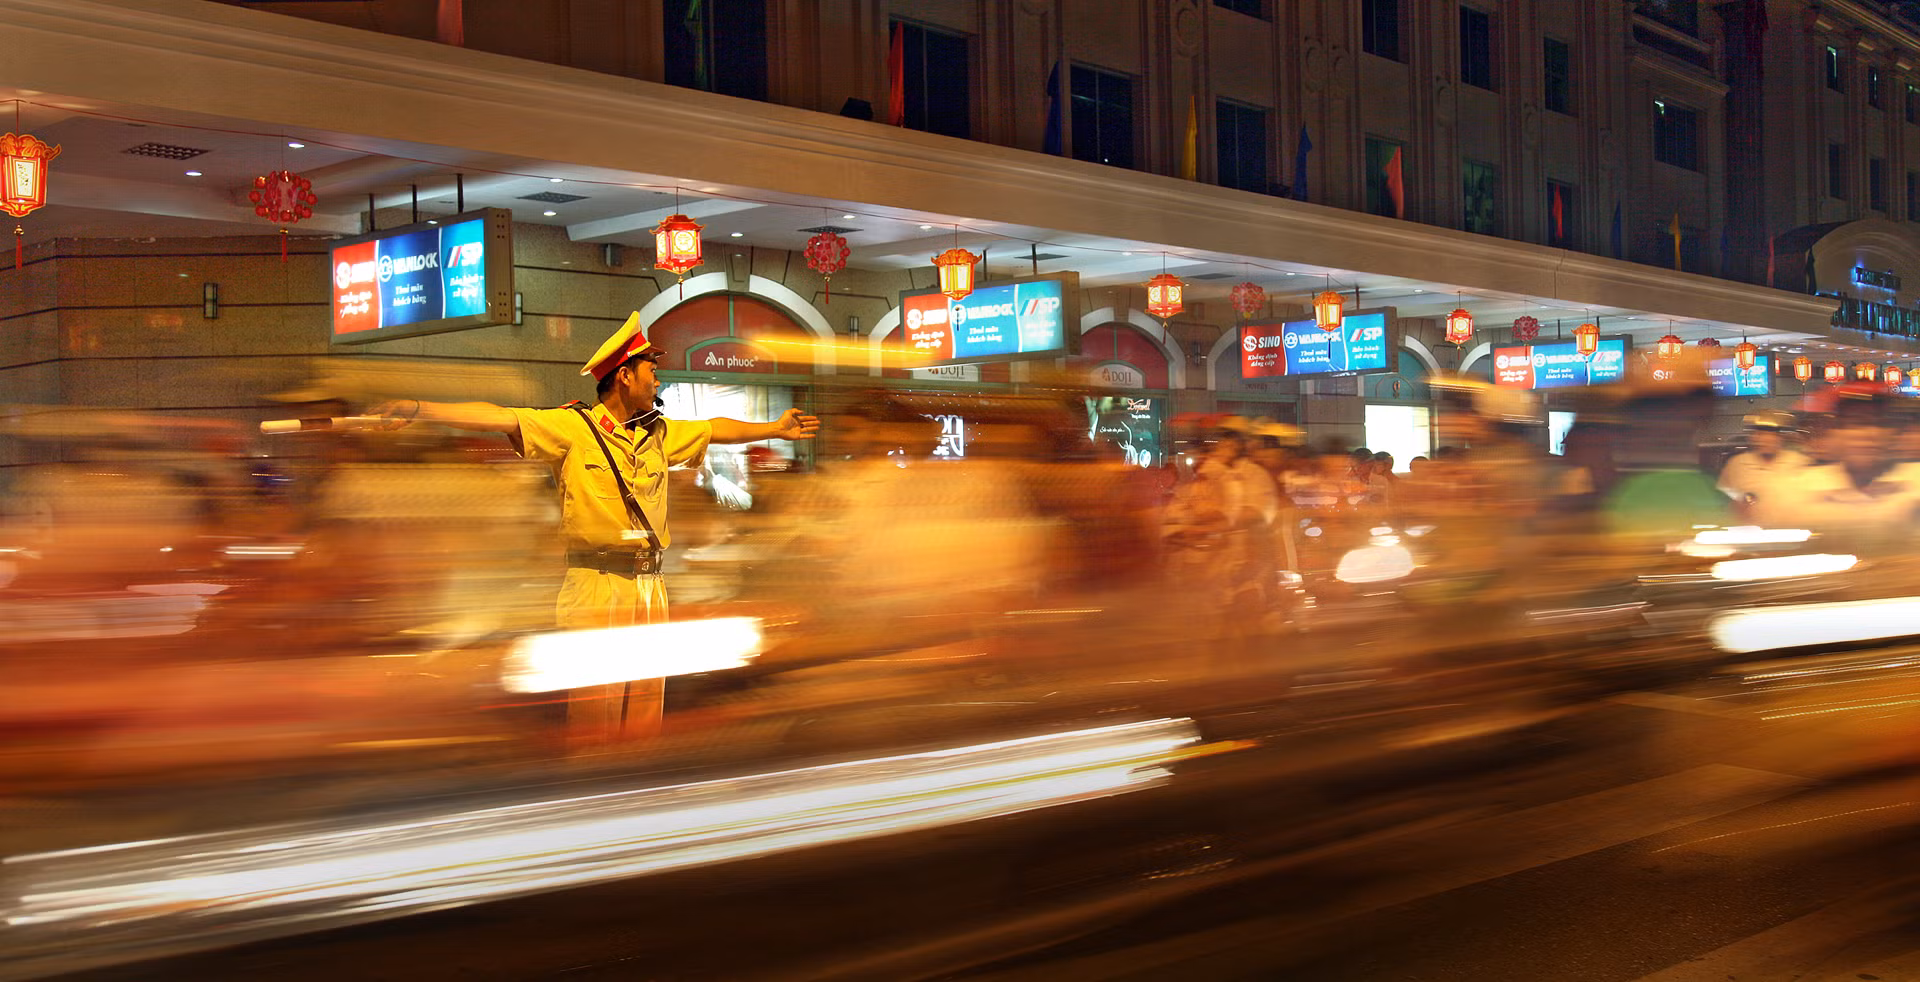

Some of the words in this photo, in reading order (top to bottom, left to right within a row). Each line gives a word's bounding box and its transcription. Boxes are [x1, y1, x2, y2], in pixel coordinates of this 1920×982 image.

[1258, 336, 1281, 349] SINO
[940, 366, 965, 378] DOJI
[1111, 371, 1132, 385] DOJI
